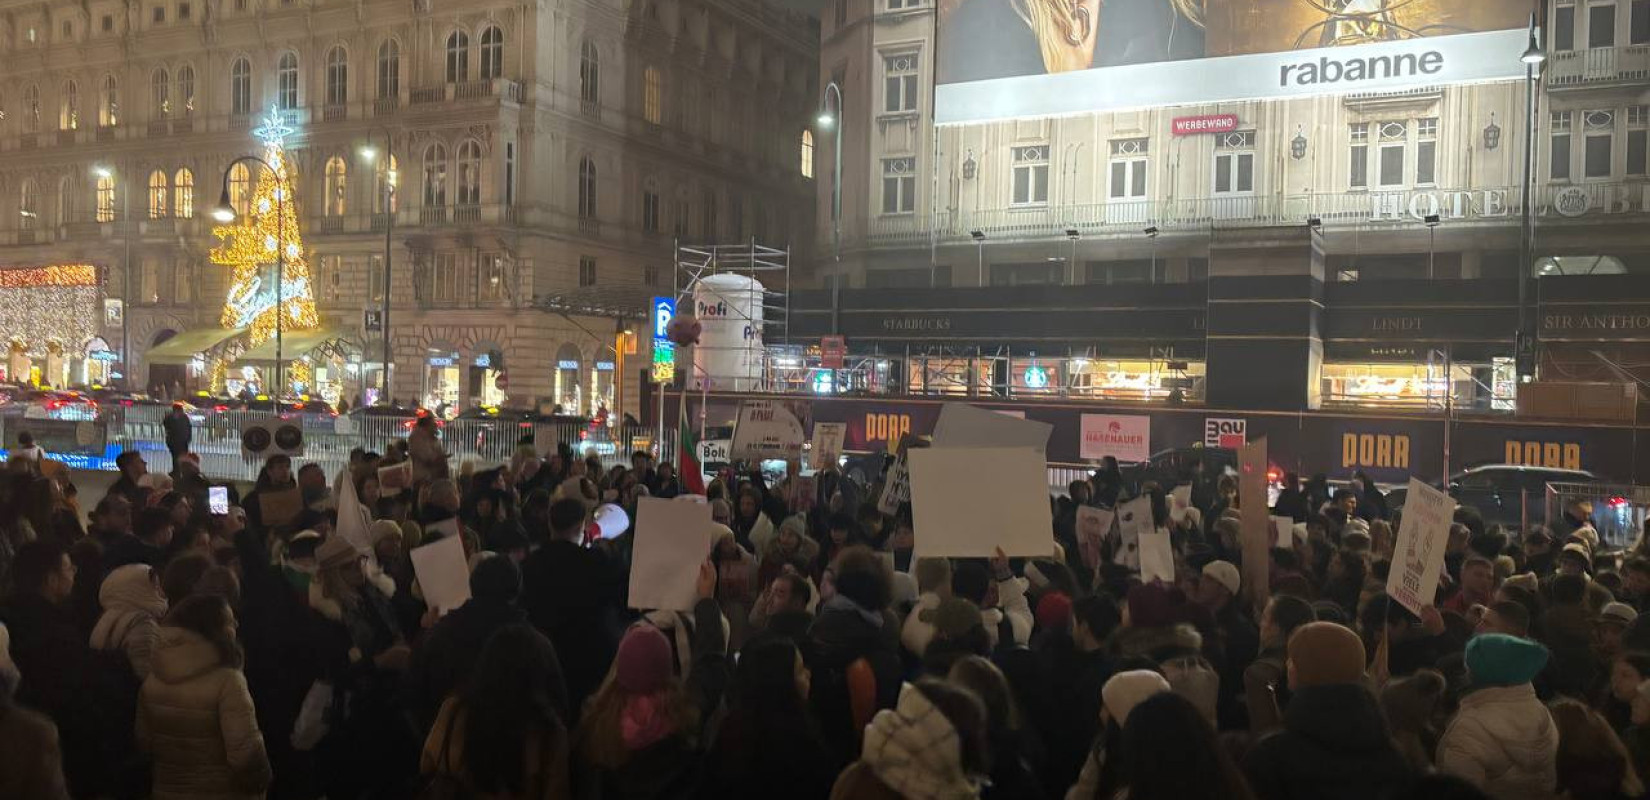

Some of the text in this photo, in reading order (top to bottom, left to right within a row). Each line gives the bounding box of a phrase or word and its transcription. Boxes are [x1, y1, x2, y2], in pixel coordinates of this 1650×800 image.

[1280, 50, 1444, 87] rabanne
[1176, 118, 1233, 130] WERBEWAND
[698, 301, 728, 316] Profi
[657, 309, 671, 336] P
[1373, 317, 1422, 329] LINDT
[1545, 315, 1572, 329] SIR
[703, 446, 726, 458] Bolt
[1342, 433, 1410, 469] PORR
